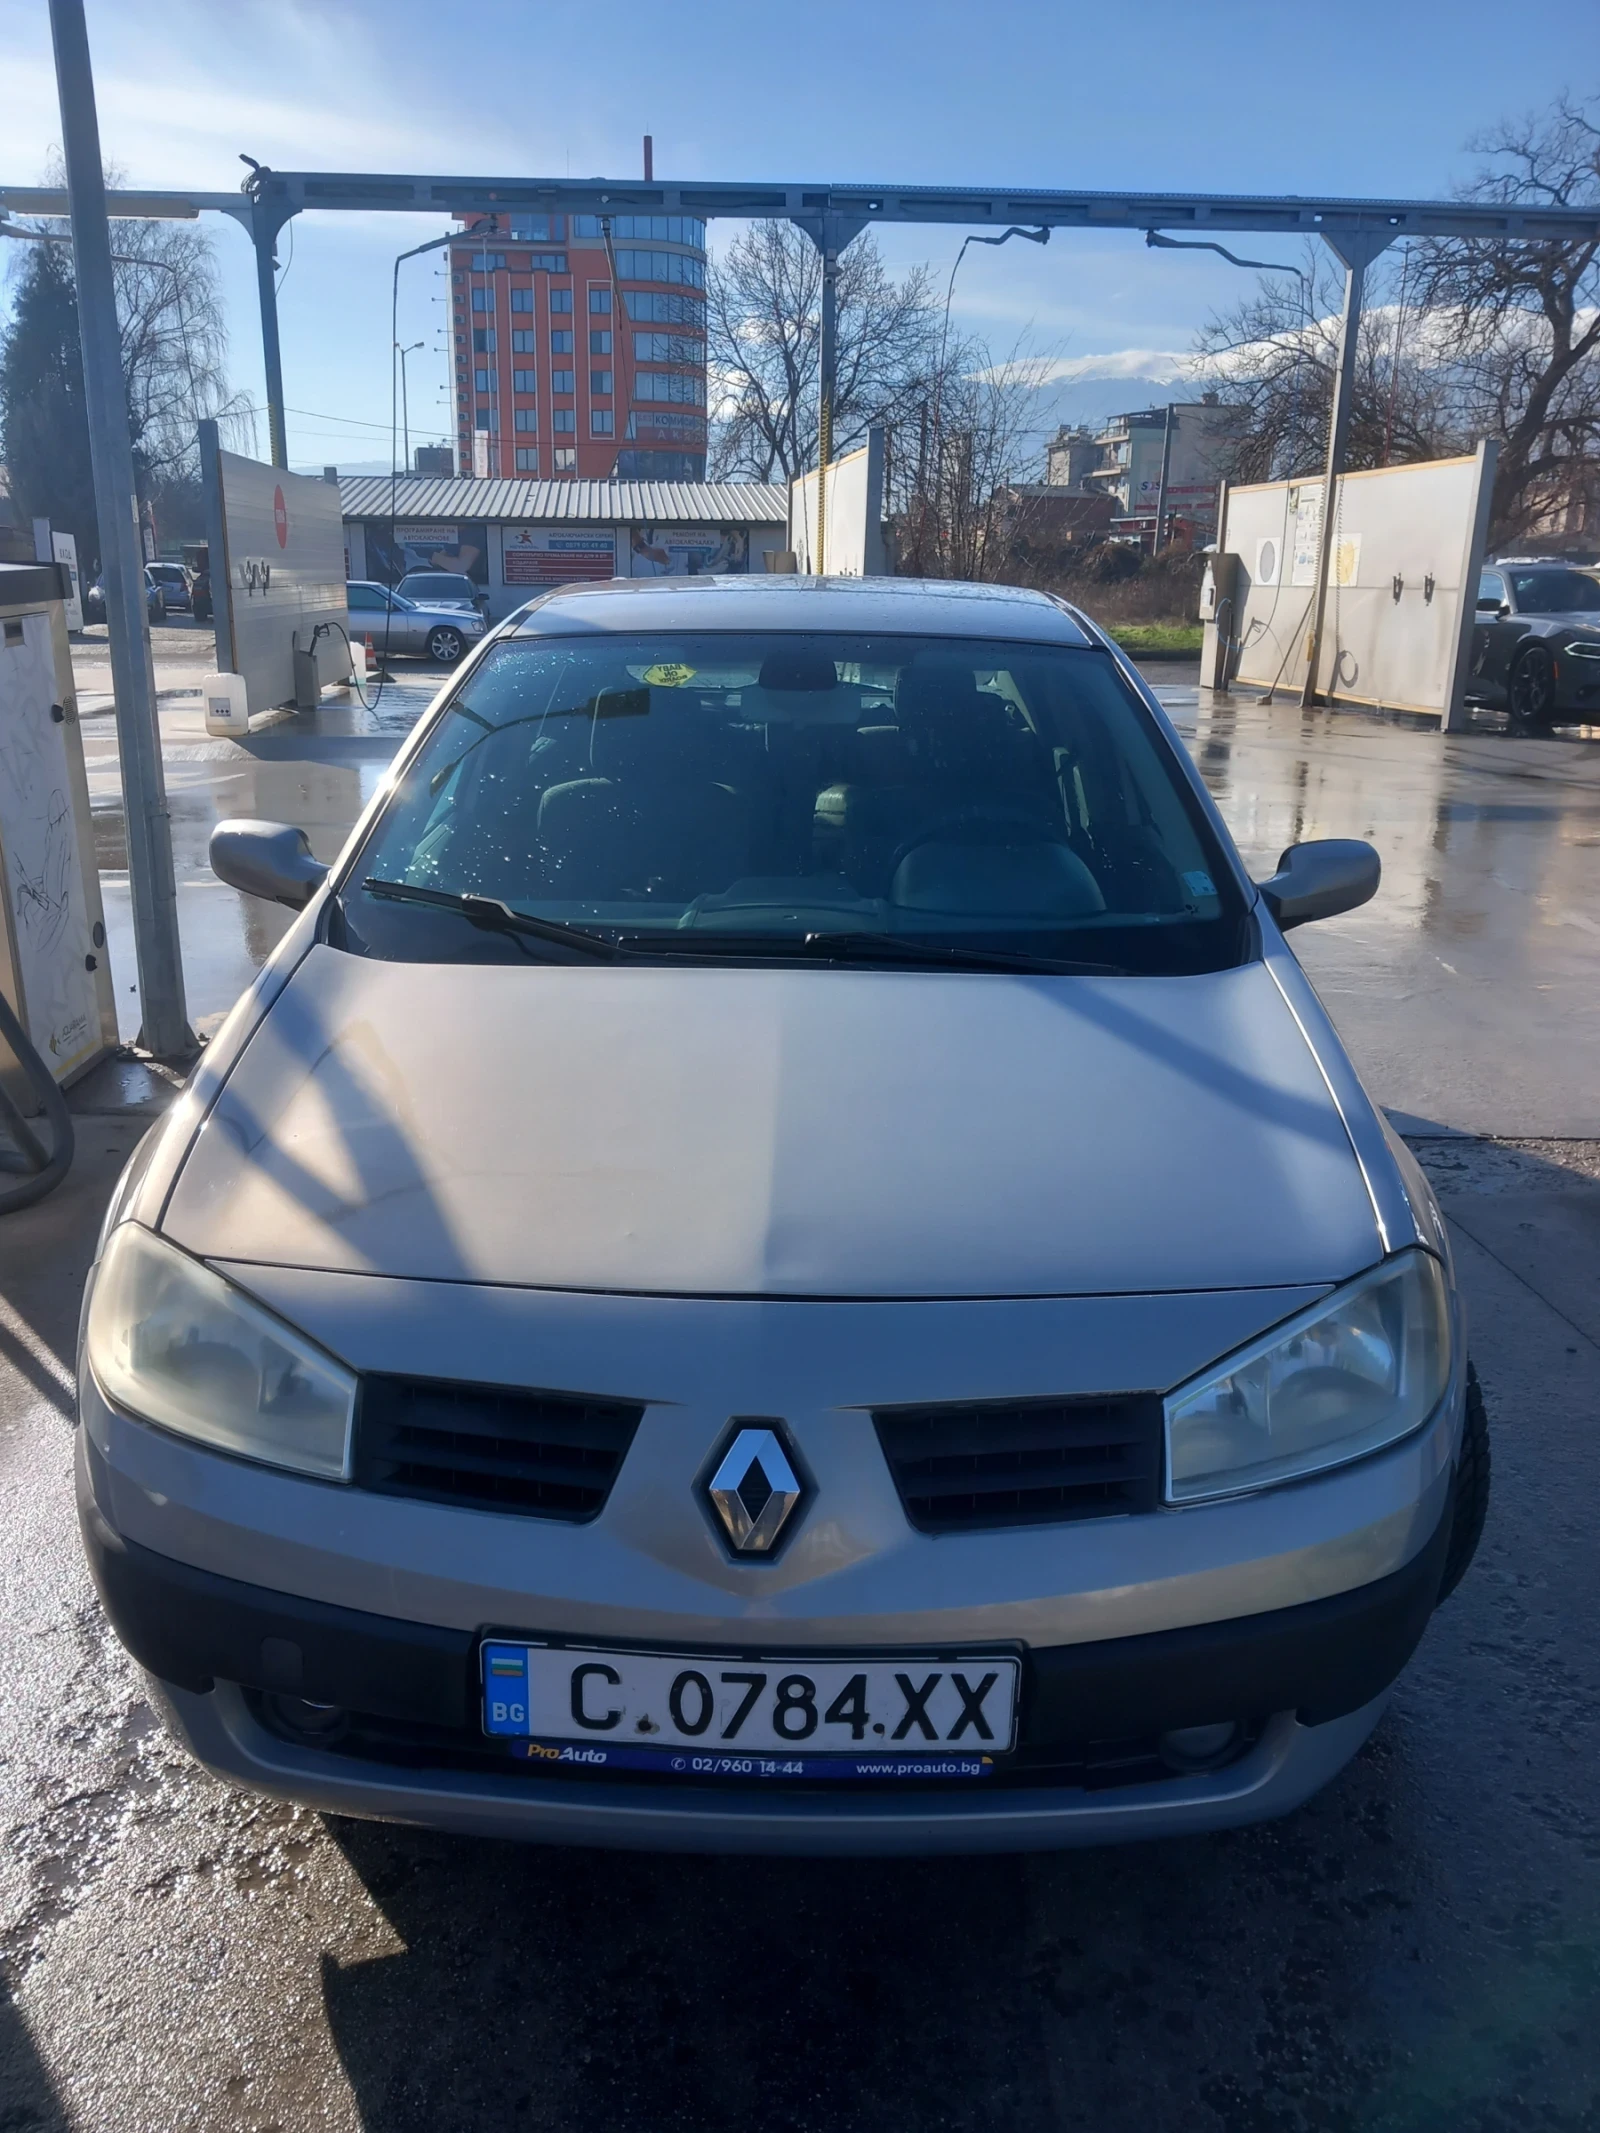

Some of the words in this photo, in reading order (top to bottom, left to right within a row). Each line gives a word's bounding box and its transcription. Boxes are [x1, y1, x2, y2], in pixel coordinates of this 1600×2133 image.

[492, 1701, 525, 1723] BG
[527, 1743, 607, 1764] ProAuto
[691, 1757, 753, 1773] 02/960
[856, 1762, 980, 1775] www.proauto.bg
